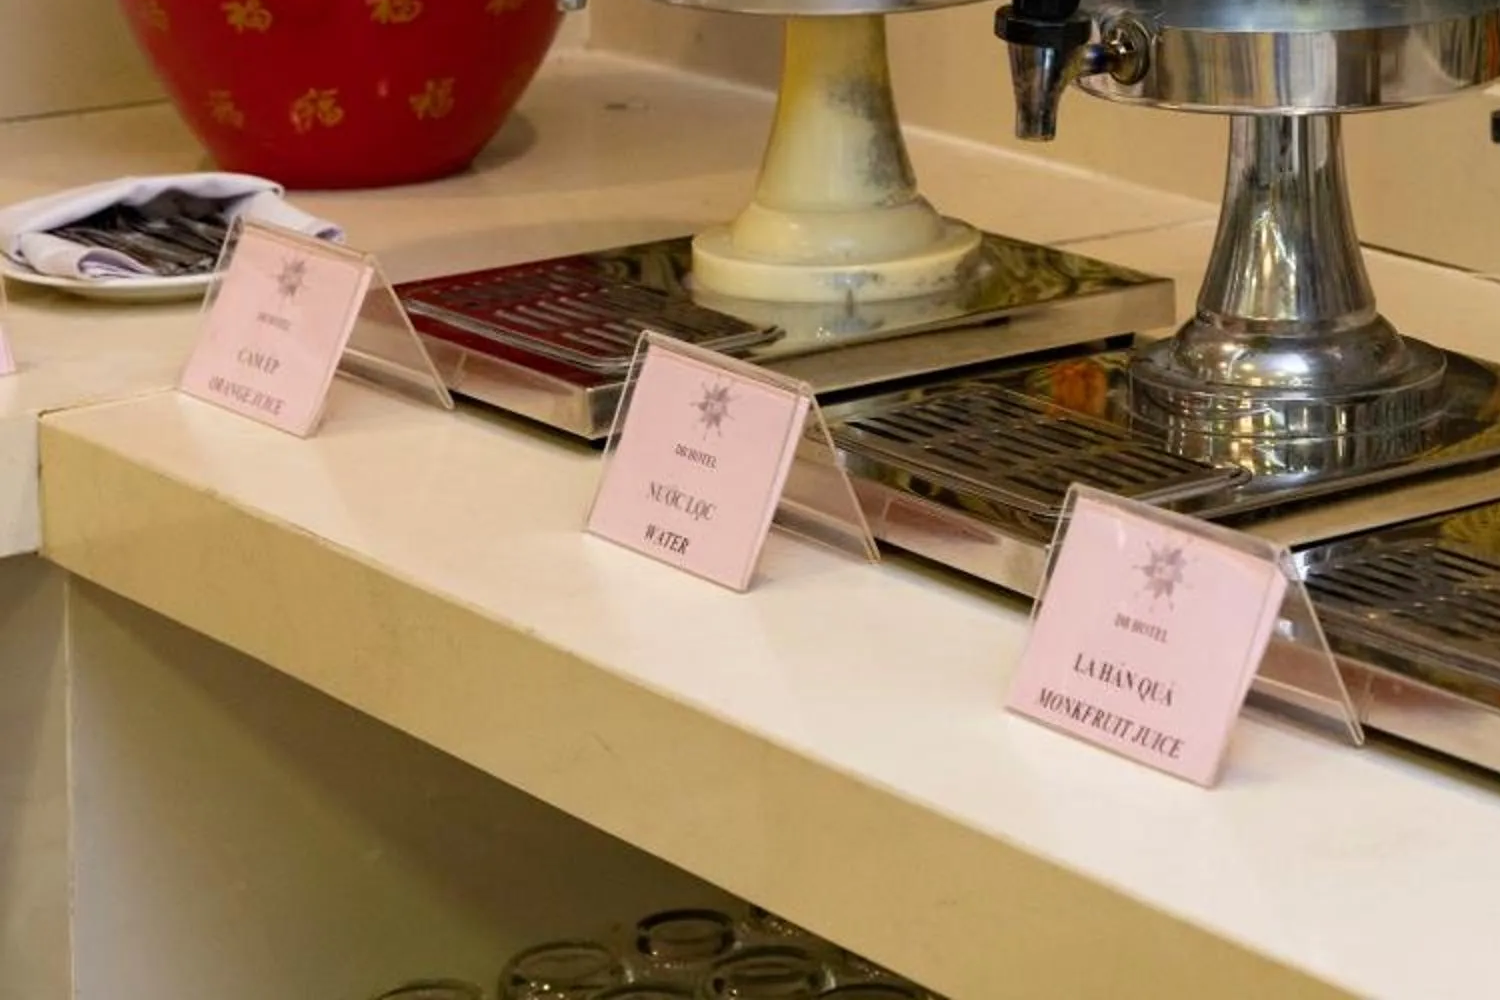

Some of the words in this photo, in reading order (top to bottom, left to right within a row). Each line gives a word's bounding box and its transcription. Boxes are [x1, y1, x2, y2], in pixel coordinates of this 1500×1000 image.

[644, 524, 690, 554] WATER
[1073, 653, 1096, 678] LA
[1038, 688, 1133, 741] MONKFRUIT
[1131, 725, 1185, 759] JUICE
